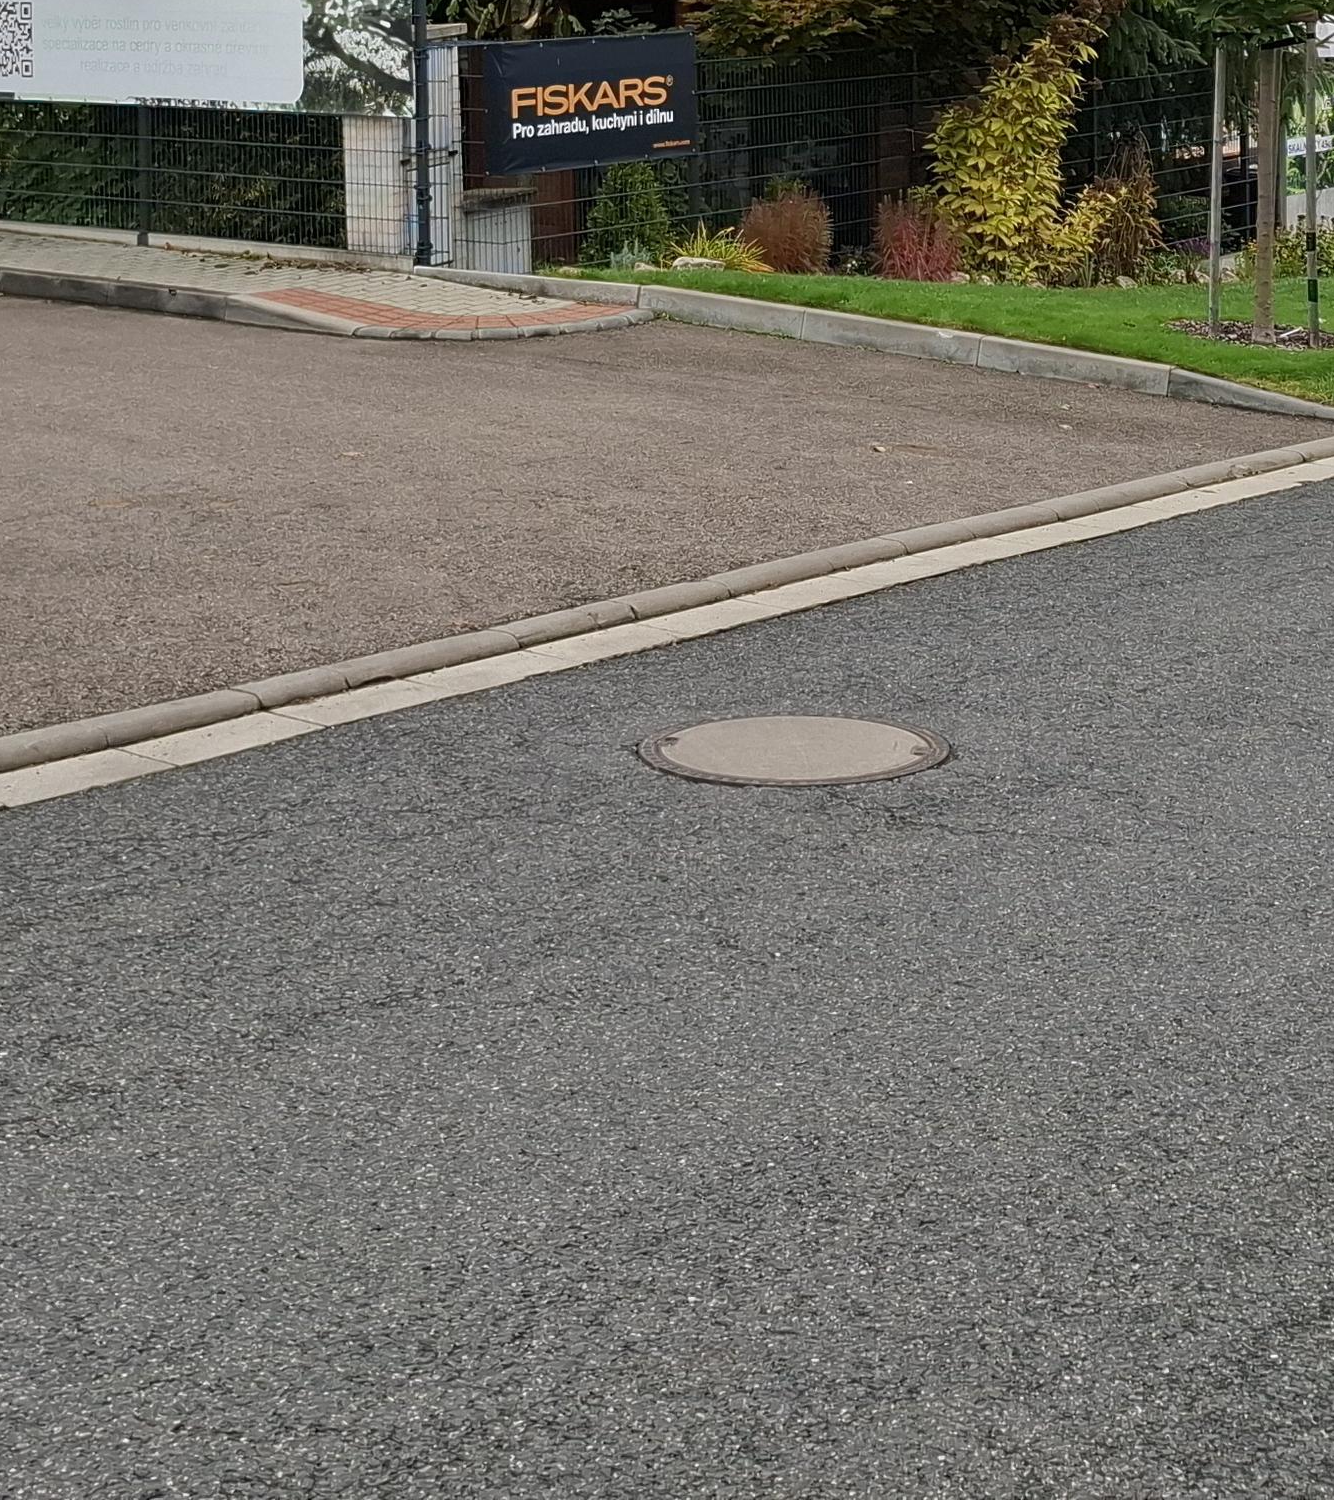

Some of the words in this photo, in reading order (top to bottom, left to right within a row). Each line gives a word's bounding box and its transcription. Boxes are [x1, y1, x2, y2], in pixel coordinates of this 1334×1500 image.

[142, 18, 162, 33] pro
[112, 40, 126, 52] na
[163, 41, 172, 53] a
[511, 75, 668, 119] FISKARS
[512, 122, 535, 139] Pro
[537, 116, 590, 137] zahradu,
[591, 111, 637, 132] kuchyni
[645, 108, 674, 125] dílnu
